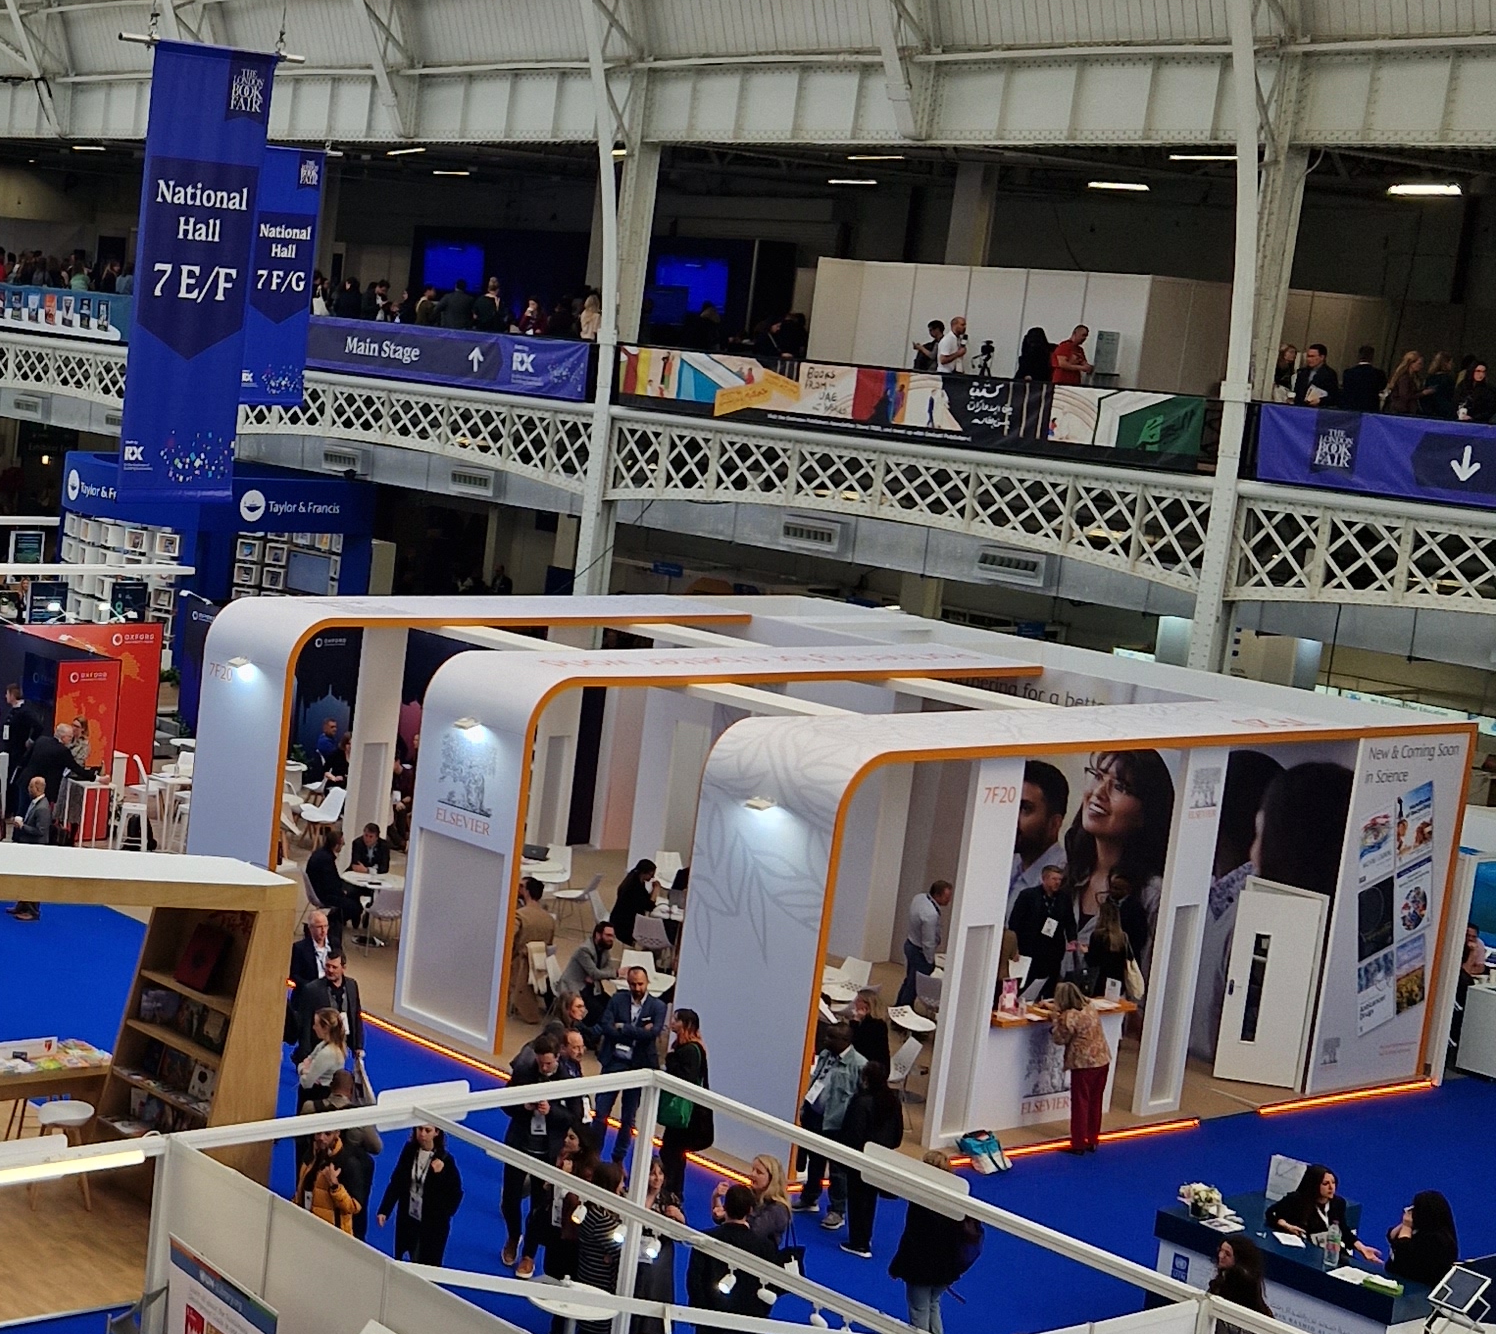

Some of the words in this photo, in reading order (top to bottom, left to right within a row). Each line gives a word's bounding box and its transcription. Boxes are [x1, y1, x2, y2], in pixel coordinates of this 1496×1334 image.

[233, 75, 265, 87] LONDON
[241, 68, 258, 79] THE
[232, 83, 263, 100] BOOK
[229, 97, 263, 113] FAIR
[156, 179, 249, 211] National
[177, 216, 221, 242] Hall
[259, 223, 312, 241] National
[271, 243, 297, 259] Hall
[345, 335, 379, 357] Main
[381, 339, 421, 364] Stage
[512, 352, 537, 373] RX
[1320, 434, 1353, 445] LONDON
[1328, 428, 1346, 438] THE
[124, 445, 145, 462] RX
[1317, 442, 1352, 456] BOOK
[1314, 452, 1351, 468] FAIR
[80, 480, 100, 498] Taylor
[100, 484, 108, 499] &
[268, 500, 297, 515] Taylor
[297, 502, 306, 514] &
[307, 502, 341, 515] Francis
[124, 633, 155, 641] OXFORD
[1022, 682, 1046, 702] for
[1049, 692, 1060, 706] a
[1368, 746, 1390, 761] New
[1391, 745, 1399, 759] &
[1401, 743, 1436, 762] Coming
[1437, 743, 1460, 758] Soon
[1365, 770, 1374, 784] in
[1376, 769, 1409, 784] Science
[982, 785, 1017, 805] 7F20
[435, 807, 490, 837] ELSEVIER
[1021, 1096, 1070, 1115] ELSEVIER
[1288, 1315, 1316, 1334] RASHID
